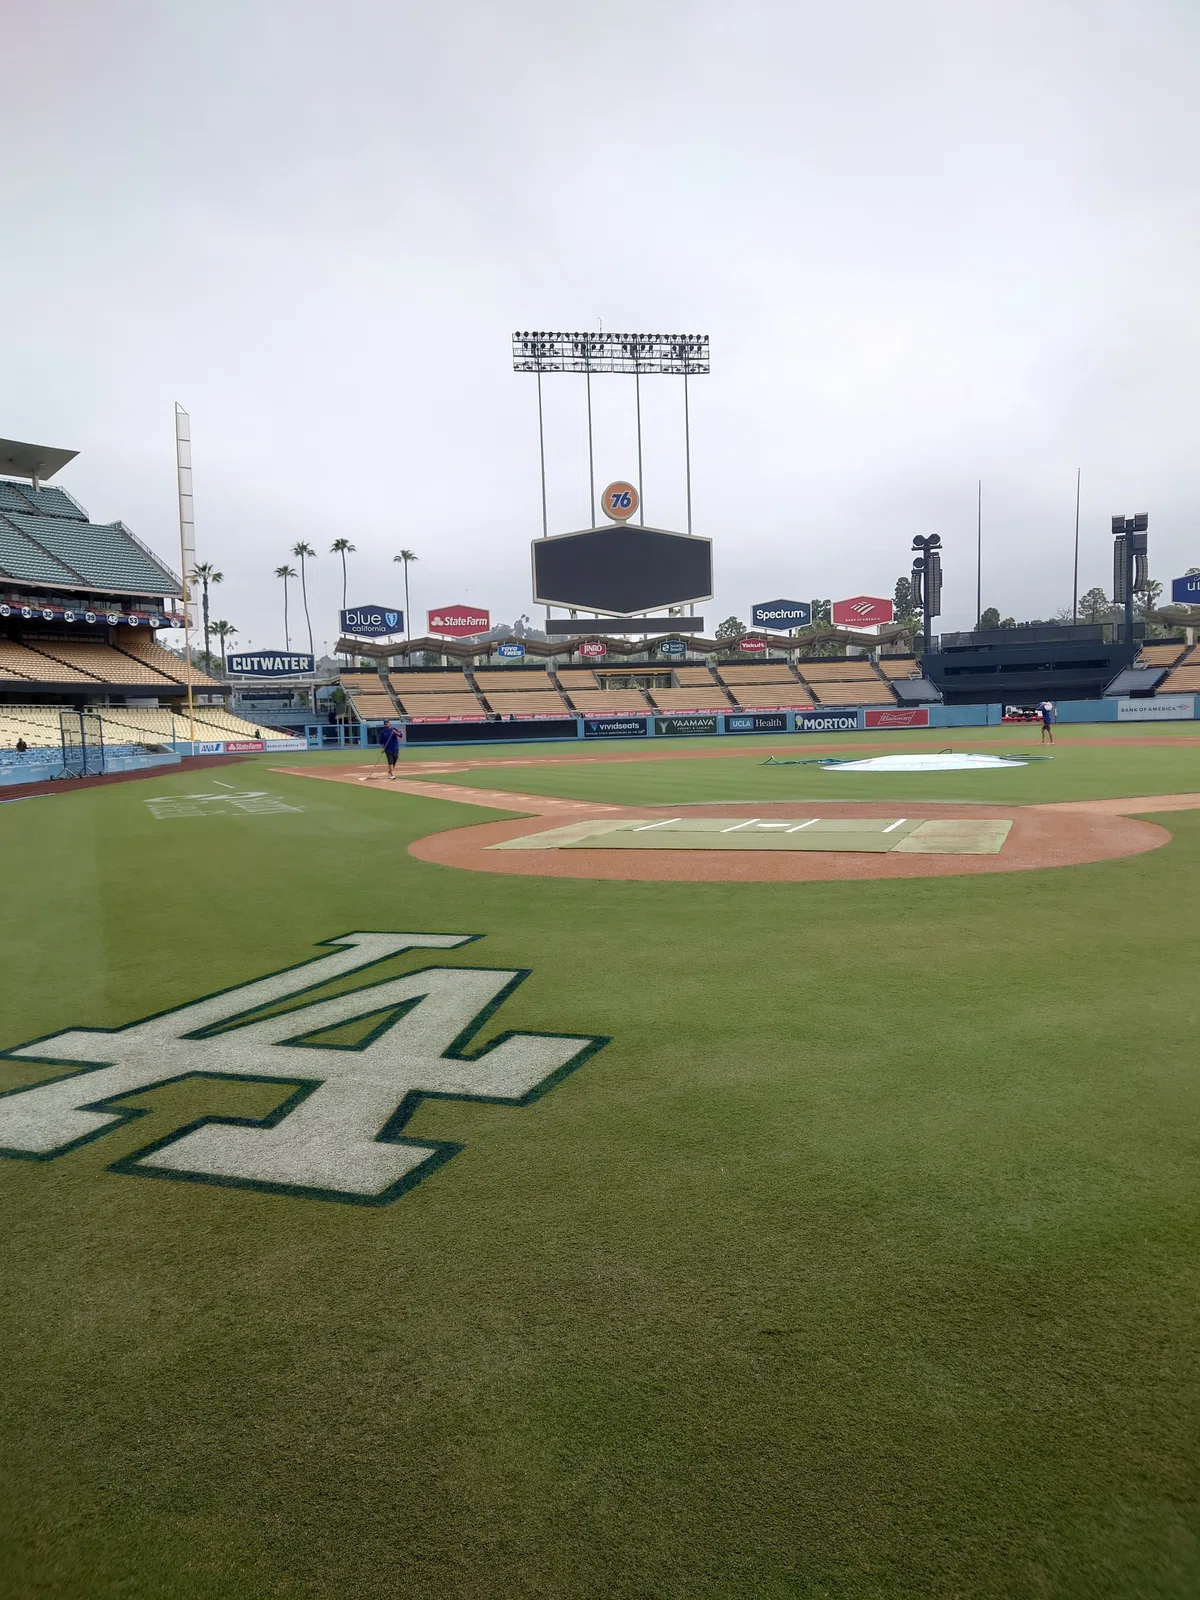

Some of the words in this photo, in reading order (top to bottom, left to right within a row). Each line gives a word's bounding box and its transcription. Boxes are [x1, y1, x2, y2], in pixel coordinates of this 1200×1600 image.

[610, 491, 632, 509] 76
[345, 611, 382, 625] blue
[756, 609, 804, 621] Spectrum
[584, 645, 602, 653] JINRO
[232, 657, 309, 671] CUTWATER
[755, 719, 782, 727] Health
[804, 717, 857, 729] MORTON
[880, 714, 913, 722] Budweiser
[201, 744, 214, 752] ANA
